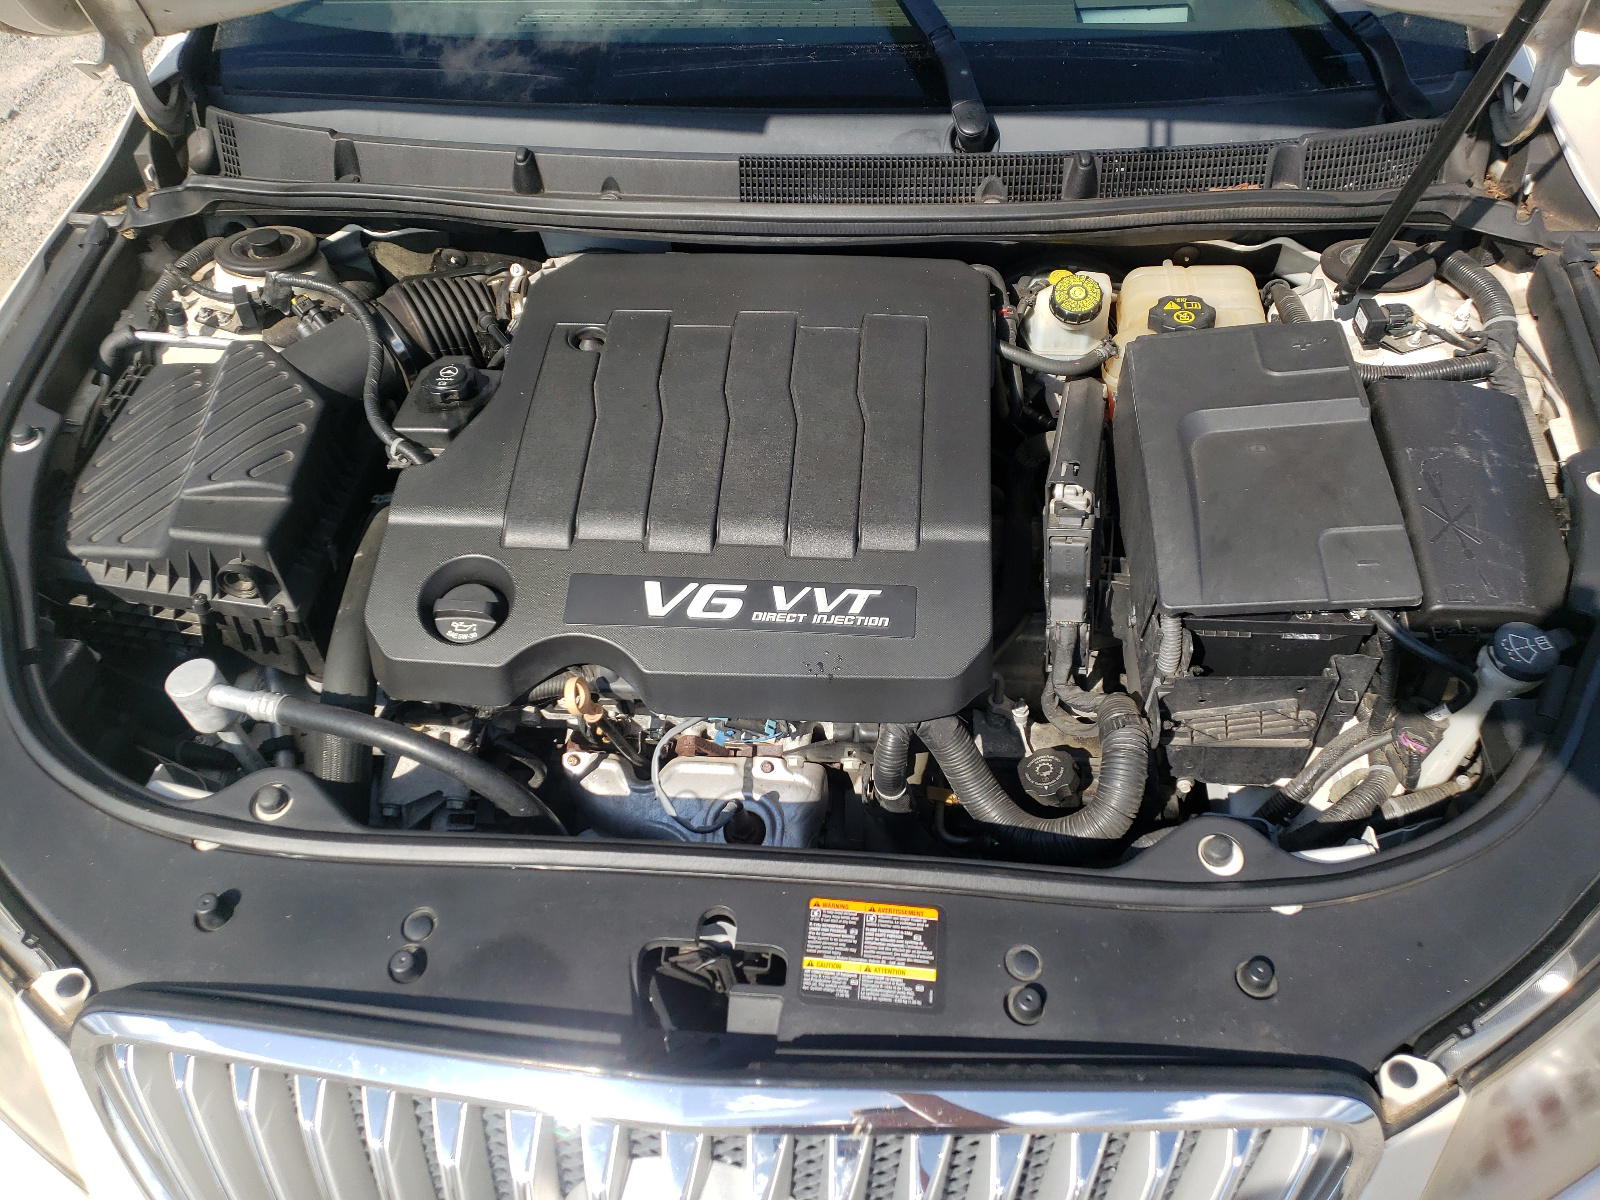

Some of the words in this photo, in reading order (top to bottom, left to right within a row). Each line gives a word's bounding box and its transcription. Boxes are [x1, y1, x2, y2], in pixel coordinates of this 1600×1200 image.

[643, 579, 748, 620] V6
[772, 585, 883, 614] VVT
[751, 611, 808, 624] DIRECT
[812, 614, 890, 627] INJECTION
[822, 902, 849, 910] WARNING
[877, 907, 924, 917] AVERTISSEMENT
[816, 961, 842, 970] CAUTION
[873, 967, 906, 976] ATTENTION
